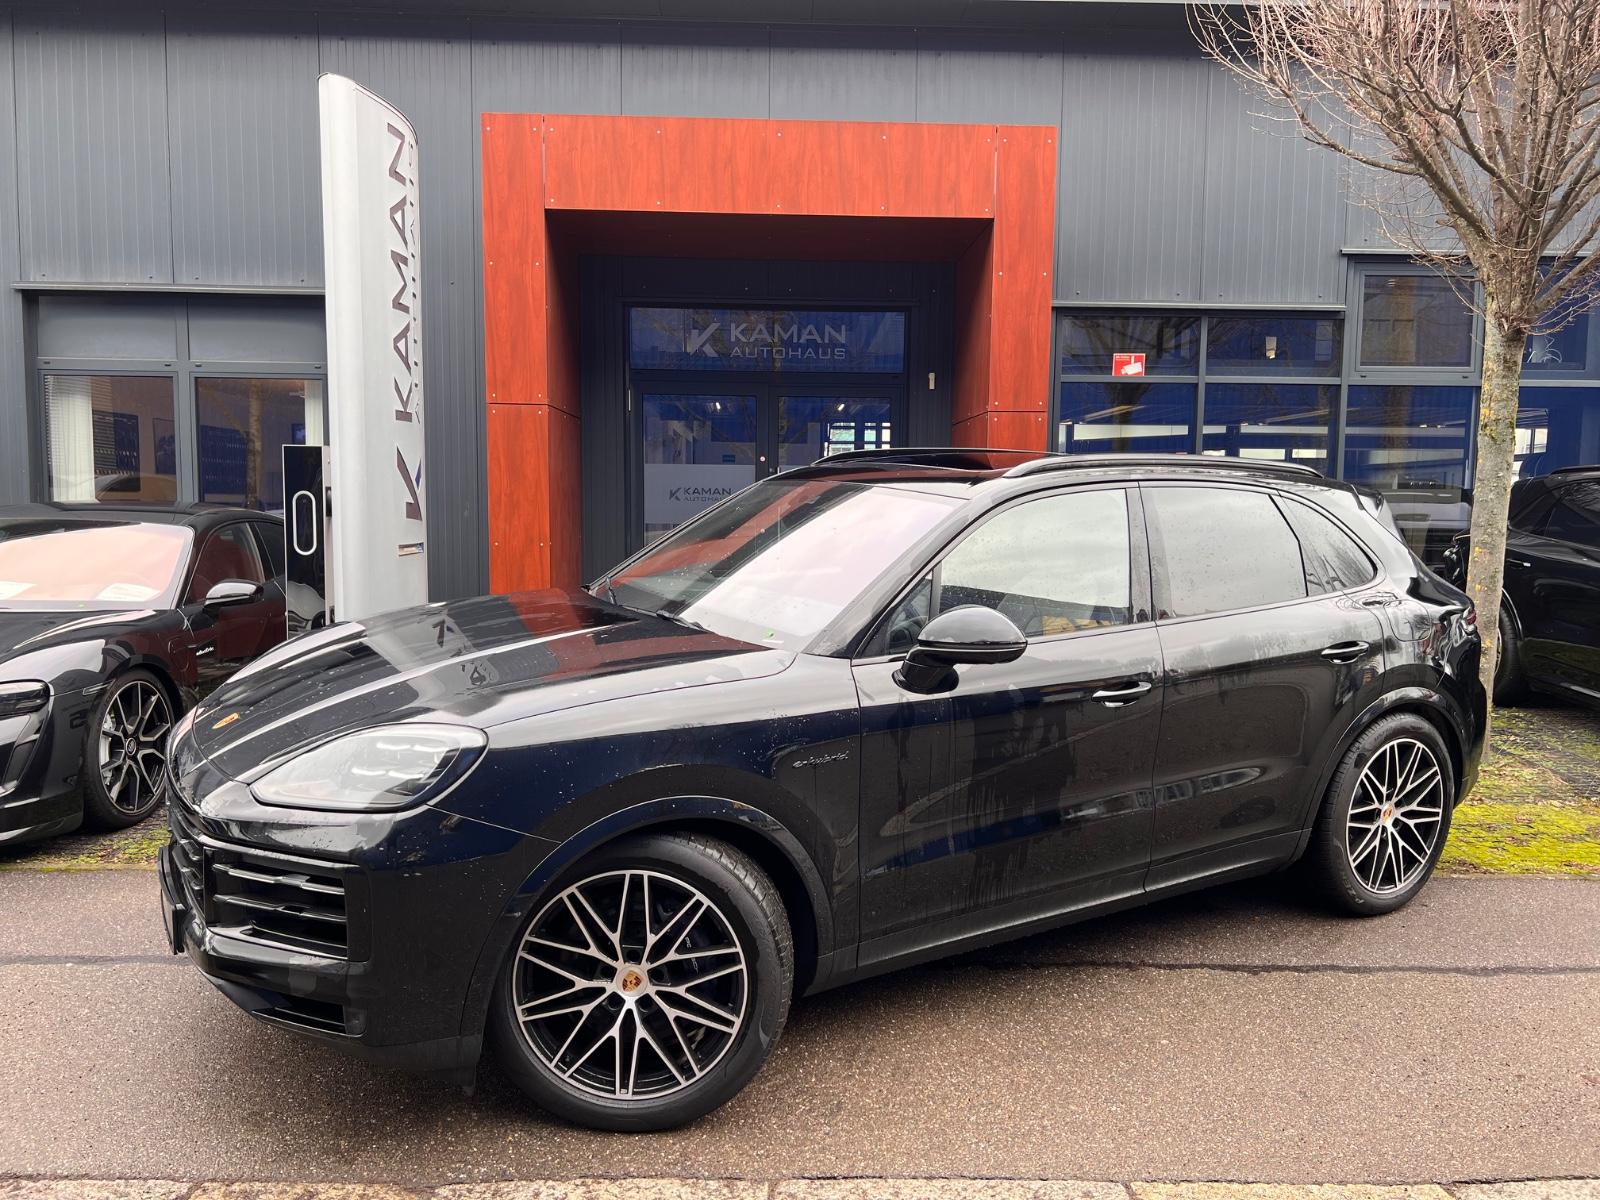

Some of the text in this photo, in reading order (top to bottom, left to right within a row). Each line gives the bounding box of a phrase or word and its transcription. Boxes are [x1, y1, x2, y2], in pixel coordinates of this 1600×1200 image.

[387, 122, 413, 423] KAMAN
[730, 323, 846, 343] KAMAN
[730, 346, 846, 359] AUTOHAUS
[683, 487, 732, 496] KAMAN
